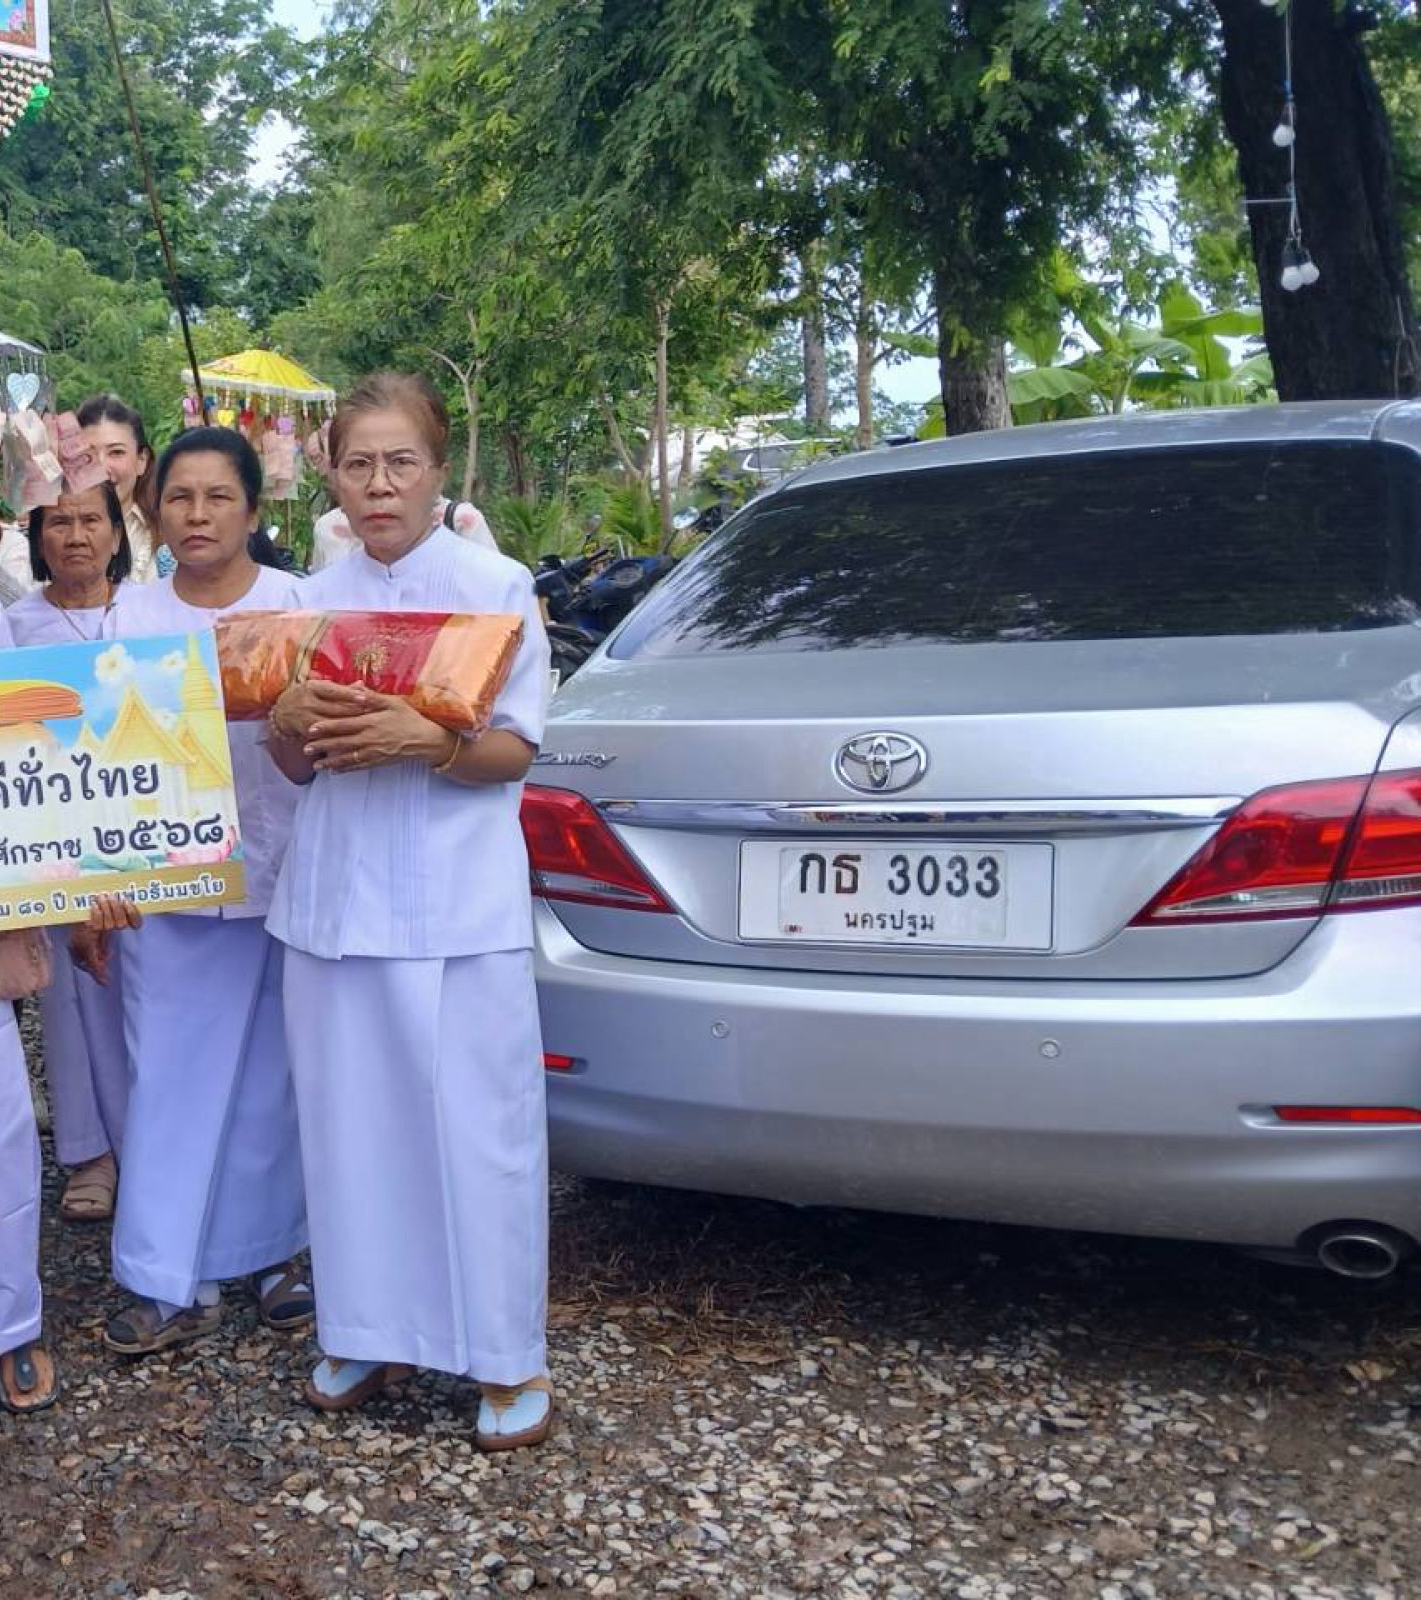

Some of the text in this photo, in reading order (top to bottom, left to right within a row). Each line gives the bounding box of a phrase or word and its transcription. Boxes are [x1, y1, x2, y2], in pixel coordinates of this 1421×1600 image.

[92, 813, 224, 855] ๒๕๖๘
[799, 852, 1001, 899] กธ 3033
[52, 891, 67, 911] ปี
[844, 909, 935, 938] นครปฐม
